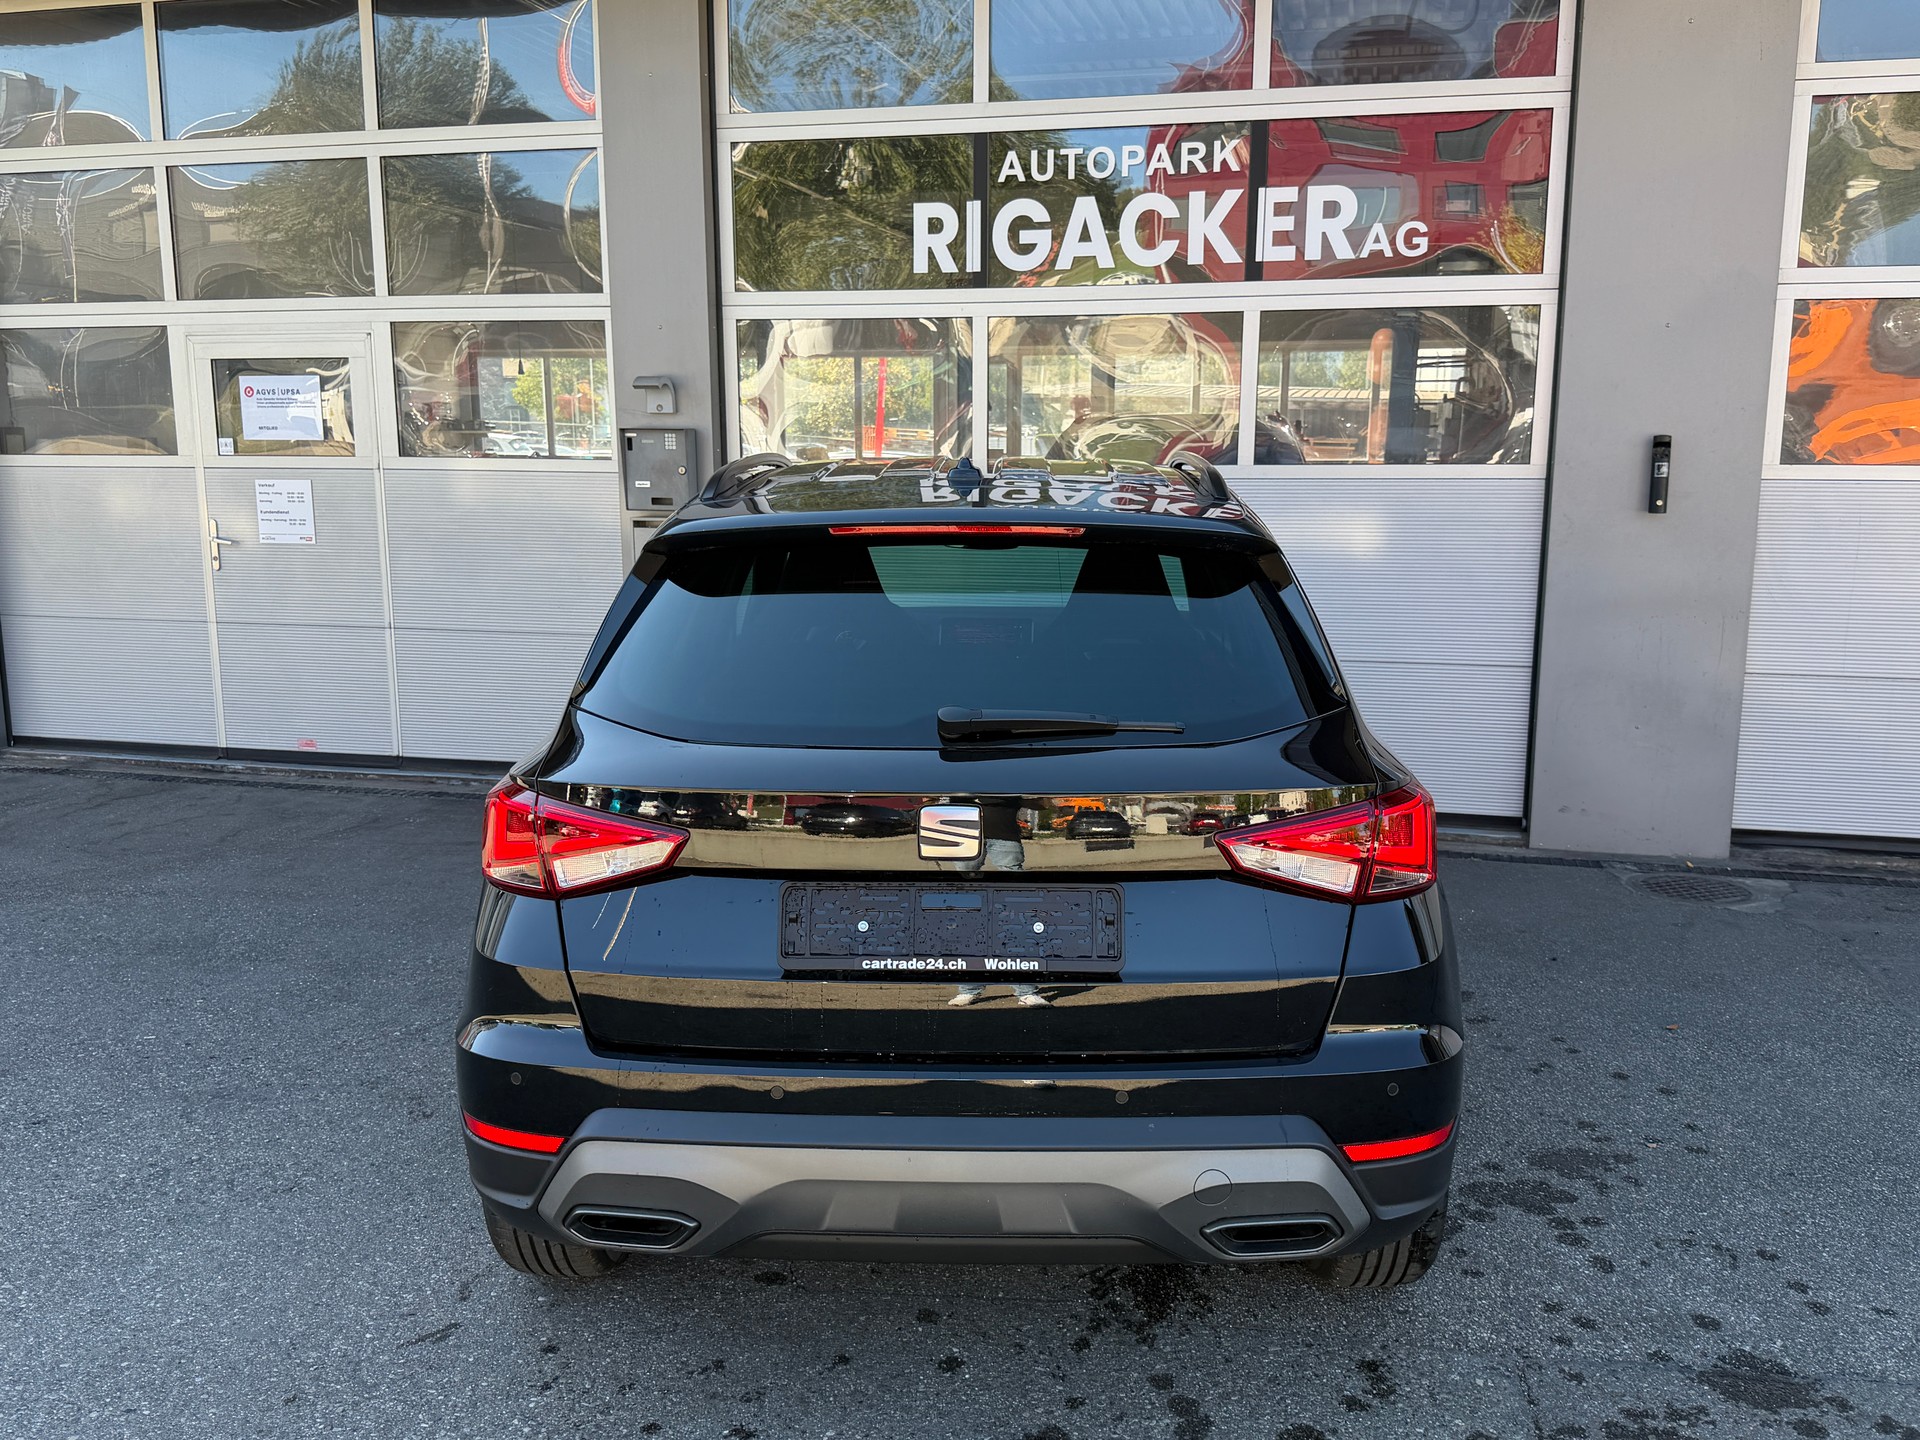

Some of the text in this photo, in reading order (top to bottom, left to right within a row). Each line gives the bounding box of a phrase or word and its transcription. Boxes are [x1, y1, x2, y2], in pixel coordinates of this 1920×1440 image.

[997, 139, 1242, 183] AUTOPARK
[912, 184, 1430, 274] RIGACKER AG
[255, 388, 301, 396] AGVS UPSA
[861, 957, 1039, 971] cartrade24.ch Wohlen
